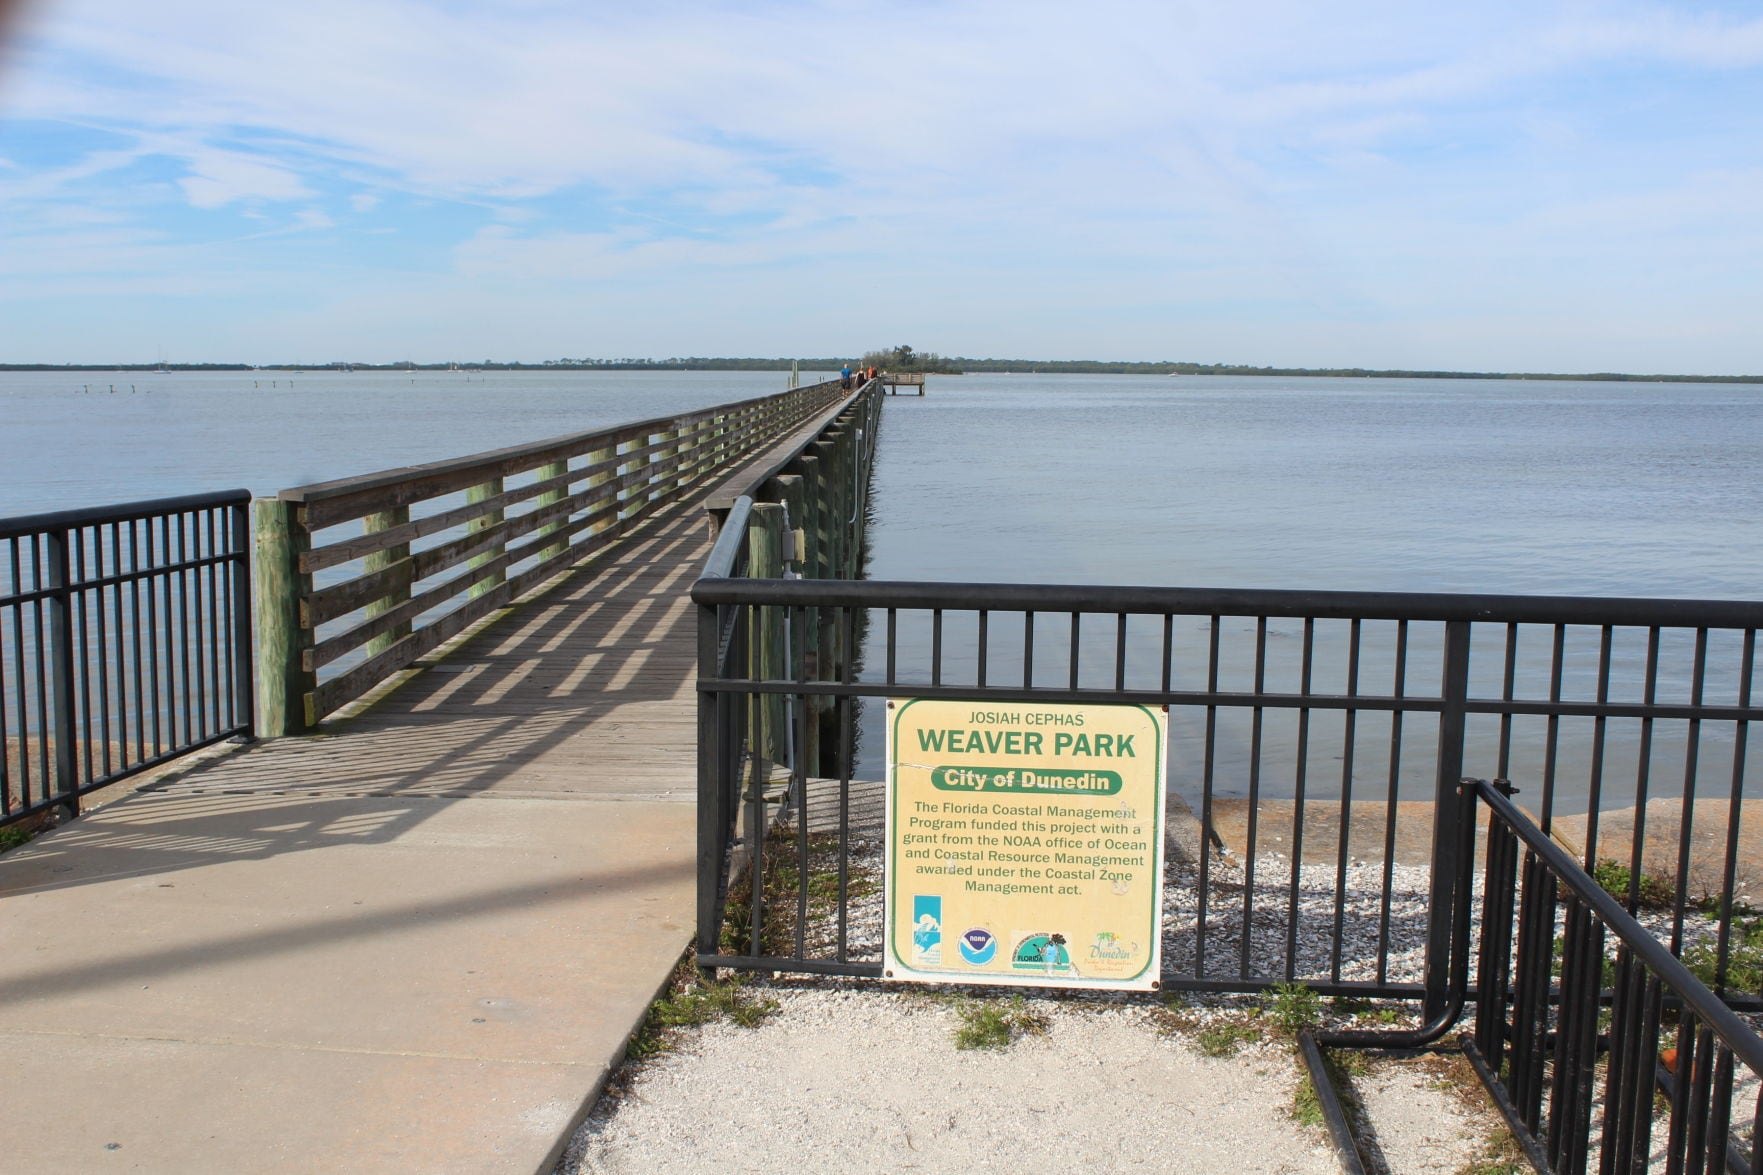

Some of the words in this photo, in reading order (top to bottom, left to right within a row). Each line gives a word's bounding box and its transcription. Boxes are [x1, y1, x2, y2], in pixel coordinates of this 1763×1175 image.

[969, 712, 1020, 724] JOSIAH
[1025, 713, 1084, 726] CEPHAS
[917, 729, 1043, 755] WEAVER
[1055, 733, 1136, 758] PARK
[944, 769, 987, 790] City
[993, 771, 1015, 787] of
[1021, 772, 1110, 790] Dunedin
[915, 802, 938, 813] The
[943, 803, 988, 815] Florida
[992, 804, 1042, 816] Coastal
[1047, 806, 1136, 821] Management
[910, 818, 966, 830] Program
[971, 819, 1017, 831] funded
[1022, 820, 1046, 832] this
[1050, 821, 1096, 835] project
[1100, 823, 1129, 834] with
[1133, 826, 1141, 835] a
[903, 834, 937, 845] grant
[942, 834, 973, 845] from
[978, 836, 998, 846] the
[1003, 836, 1041, 847] NOAA
[1046, 838, 1083, 849] office
[1087, 839, 1101, 849] of
[1105, 839, 1147, 850] Ocean
[905, 849, 930, 859] and
[934, 849, 984, 861] Coastal
[988, 851, 1050, 863] Resource
[1055, 853, 1144, 867] Management
[916, 865, 972, 876] awarded
[977, 867, 1015, 878] under
[1020, 868, 1041, 879] the
[1045, 868, 1095, 880] Coastal
[1099, 870, 1133, 881] Zone
[965, 881, 1053, 895] Management
[1058, 884, 1082, 895] act.
[1088, 944, 1130, 959] Dunedin
